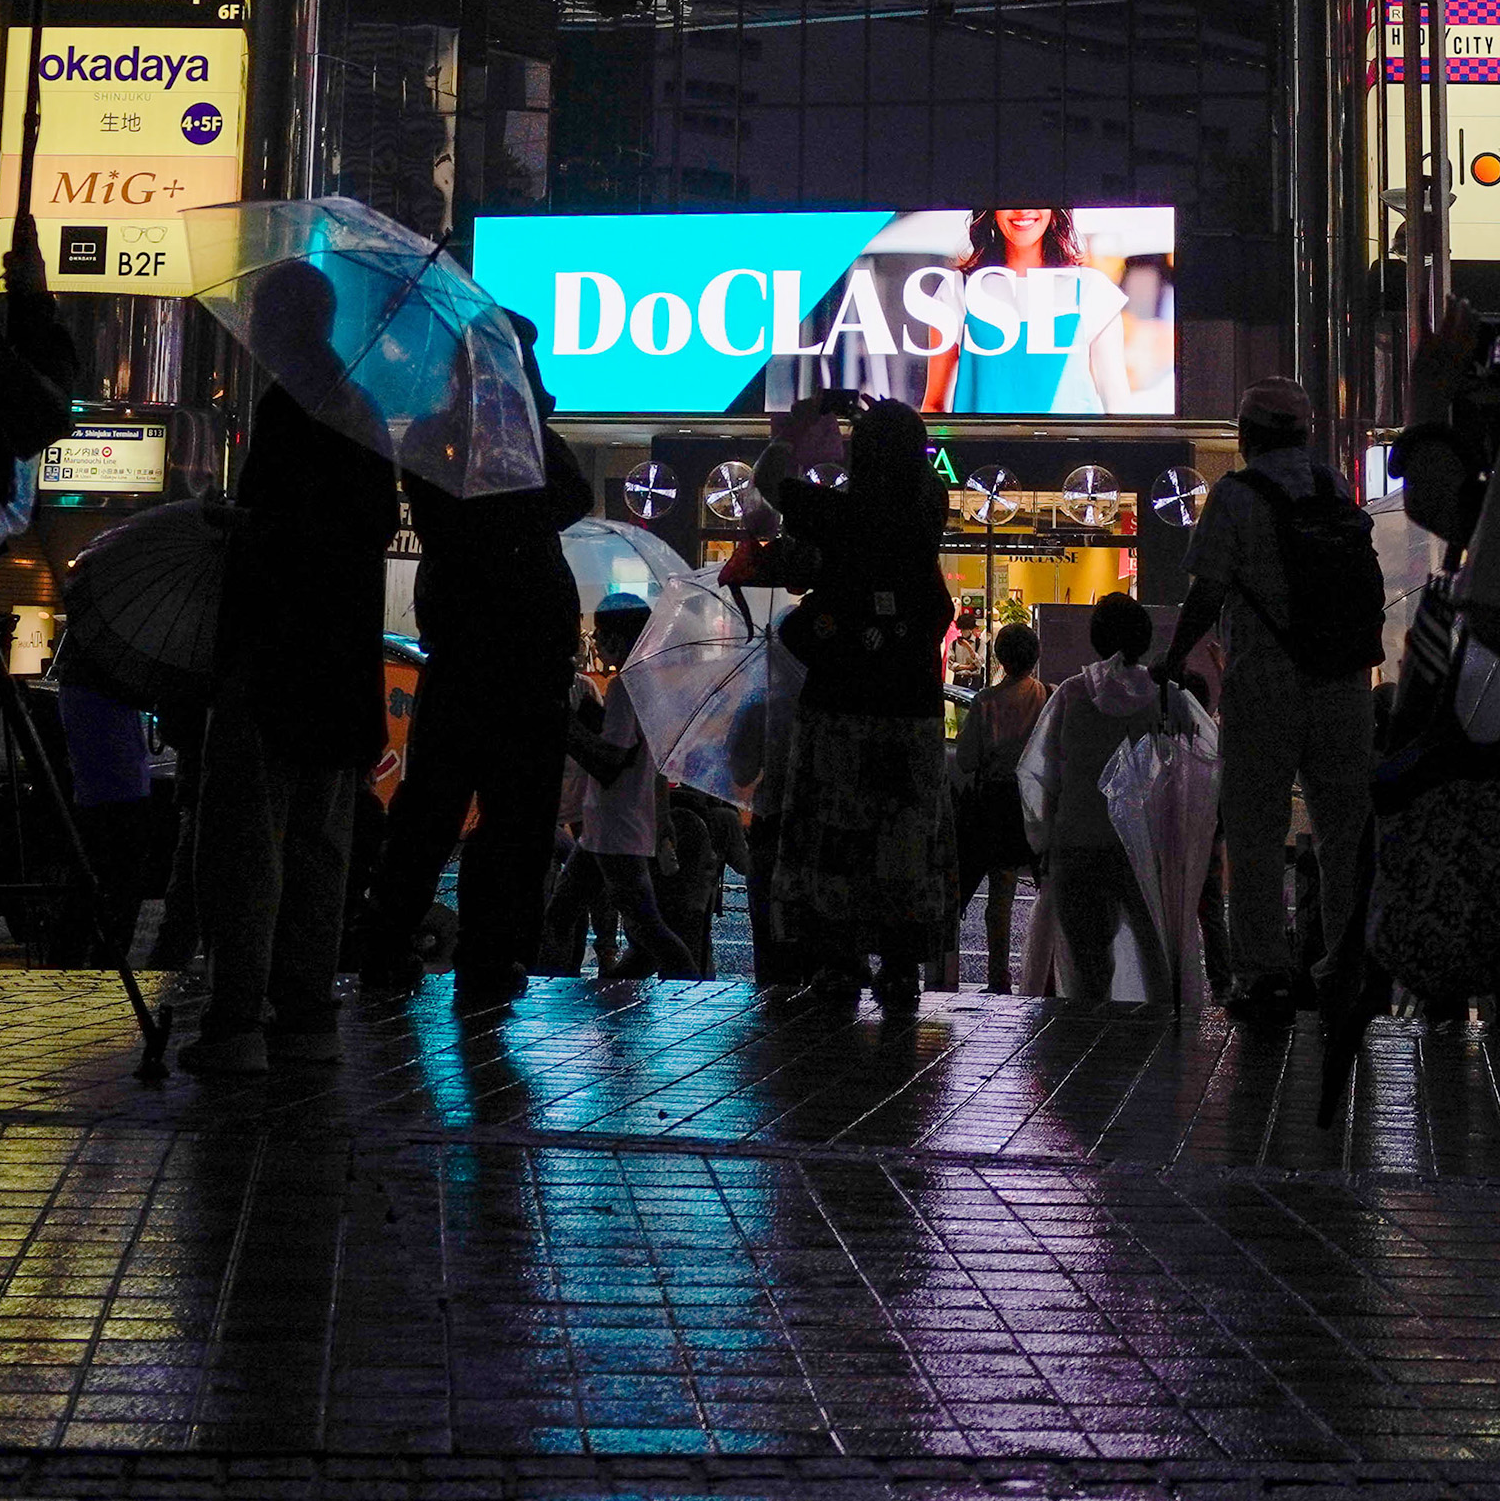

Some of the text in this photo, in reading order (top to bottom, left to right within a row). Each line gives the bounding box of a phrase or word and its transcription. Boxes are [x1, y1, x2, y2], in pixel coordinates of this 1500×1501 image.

[217, 3, 241, 21] 6F
[1453, 36, 1494, 55] CITY
[39, 45, 210, 90] okadaya
[92, 91, 153, 102] SHINJUKU
[99, 112, 142, 134] 生地
[118, 251, 167, 277] B2F
[84, 430, 112, 438] Shinjuku
[112, 430, 140, 438] Terminal
